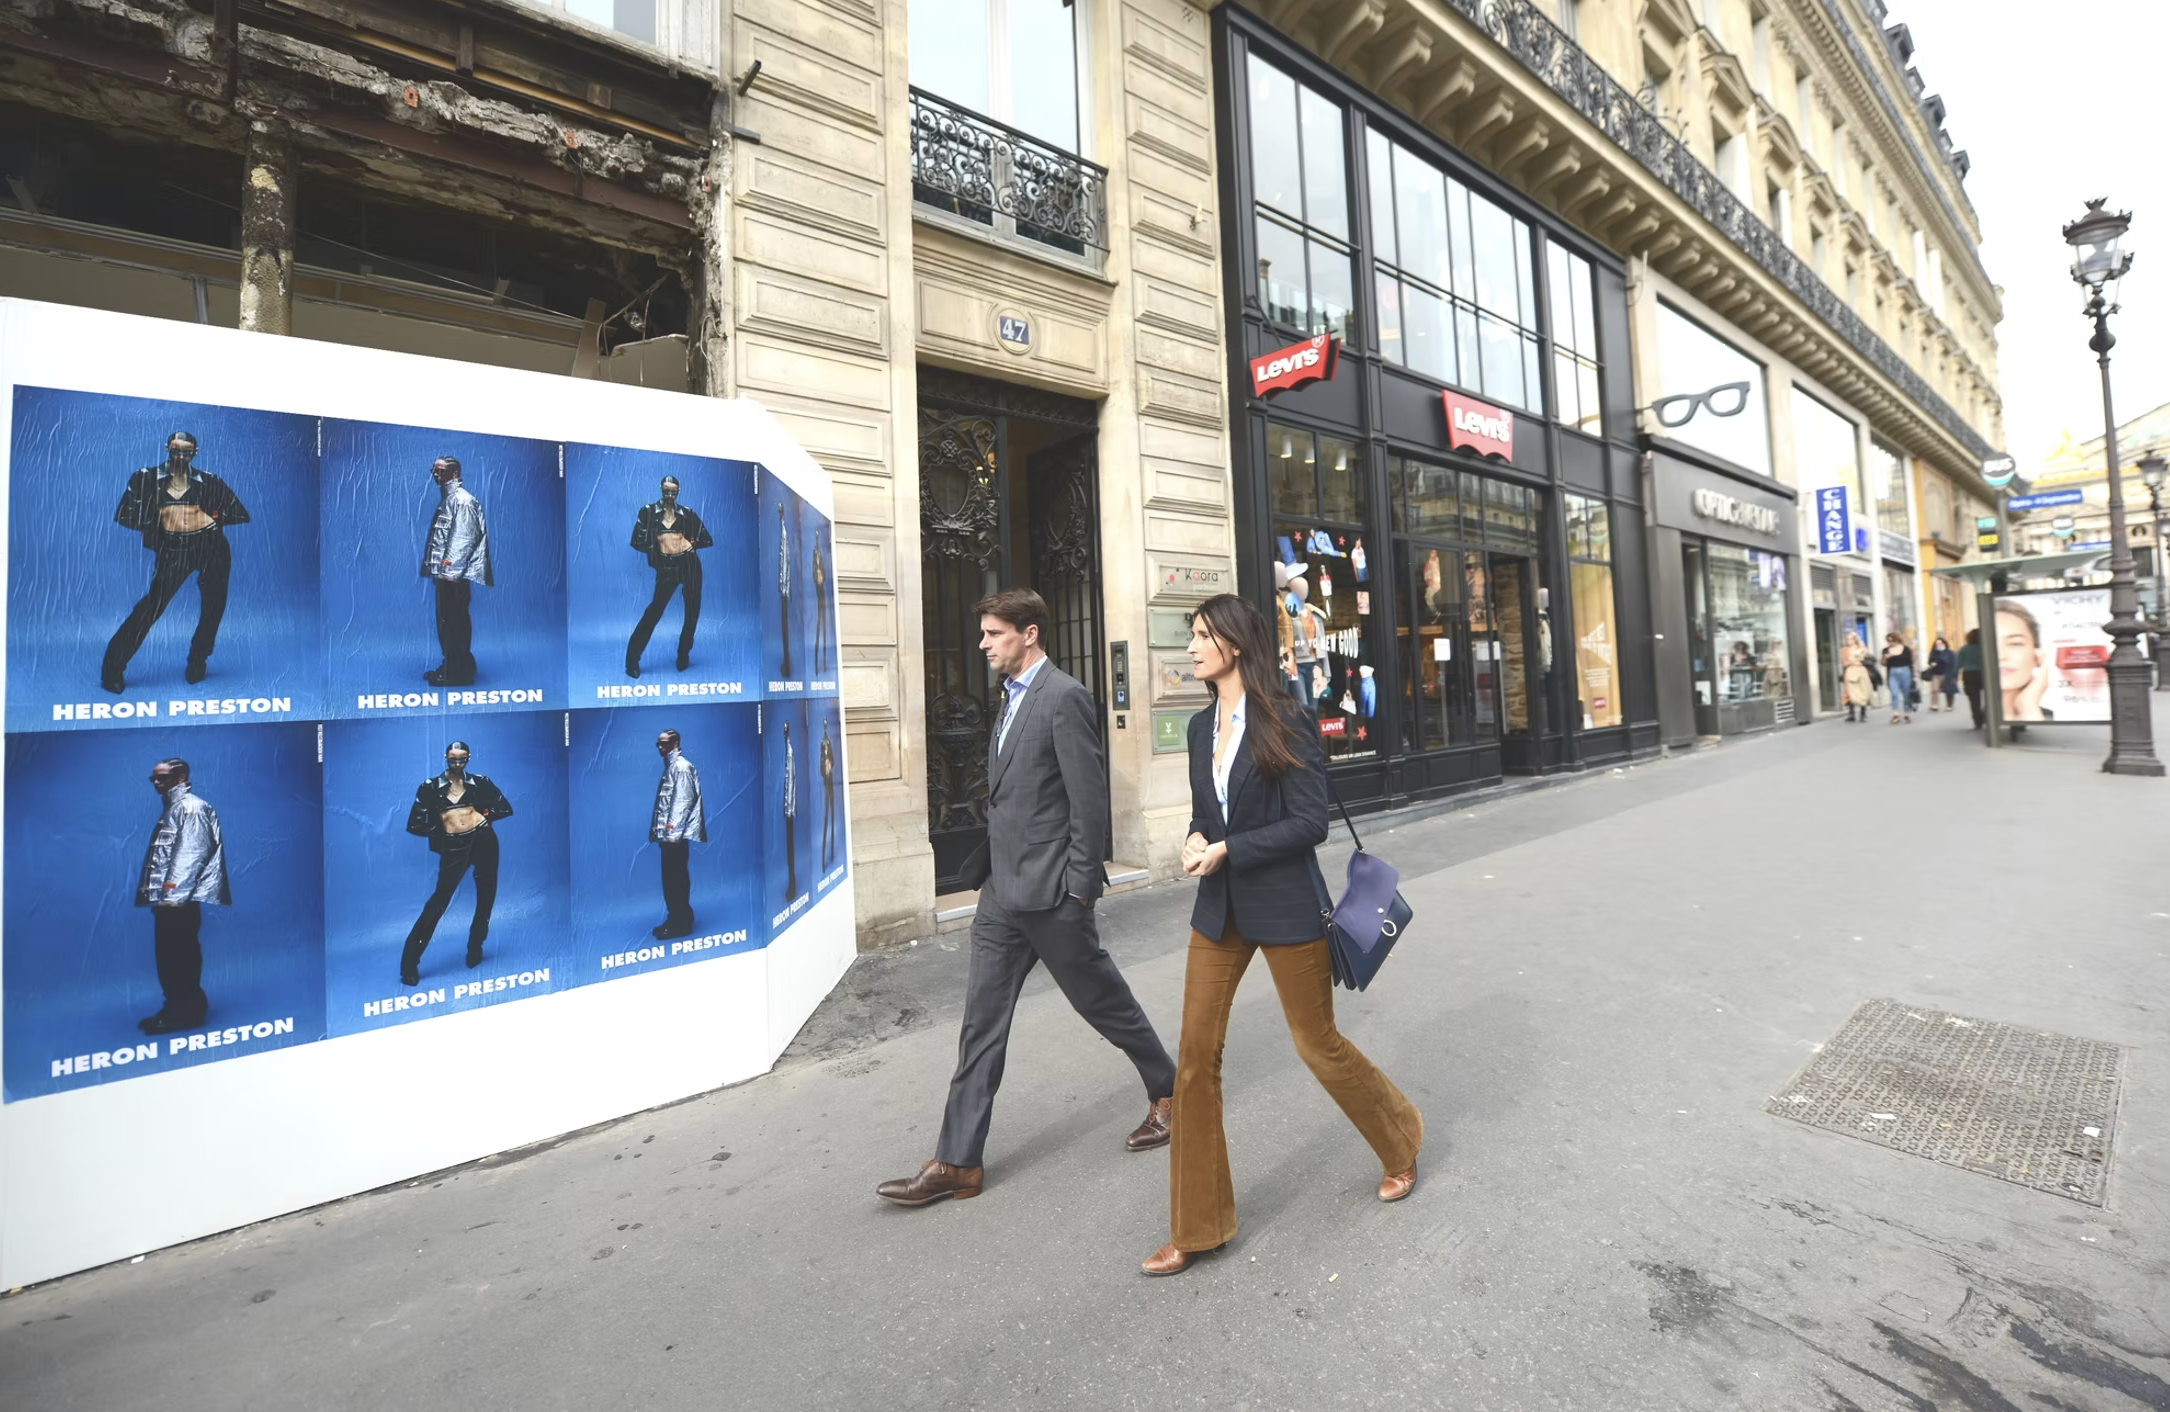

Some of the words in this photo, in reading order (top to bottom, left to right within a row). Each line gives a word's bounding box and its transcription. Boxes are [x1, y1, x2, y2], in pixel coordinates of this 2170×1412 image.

[1002, 318, 1026, 342] 47
[1823, 488, 1844, 552] CHANGE
[1184, 568, 1218, 582] Kaora
[1294, 639, 1305, 647] UP
[1307, 638, 1318, 649] TO
[1338, 627, 1359, 659] GOOD
[357, 693, 439, 709] HERON
[447, 689, 543, 706] PRESTON
[598, 685, 660, 699] HERON
[667, 682, 742, 697] PRESTON
[769, 681, 784, 692] HERON
[785, 681, 803, 691] PRESTON
[53, 701, 157, 721] HERON
[169, 697, 291, 717] PRESTON
[773, 906, 790, 930] HERON
[790, 891, 809, 915] PRESTON
[601, 945, 665, 971] HERON
[671, 929, 747, 956] PRESTON
[363, 988, 446, 1018] HERON
[454, 967, 550, 1000] PRESTON
[51, 1043, 158, 1078] HERON
[170, 1017, 294, 1056] PRESTON
